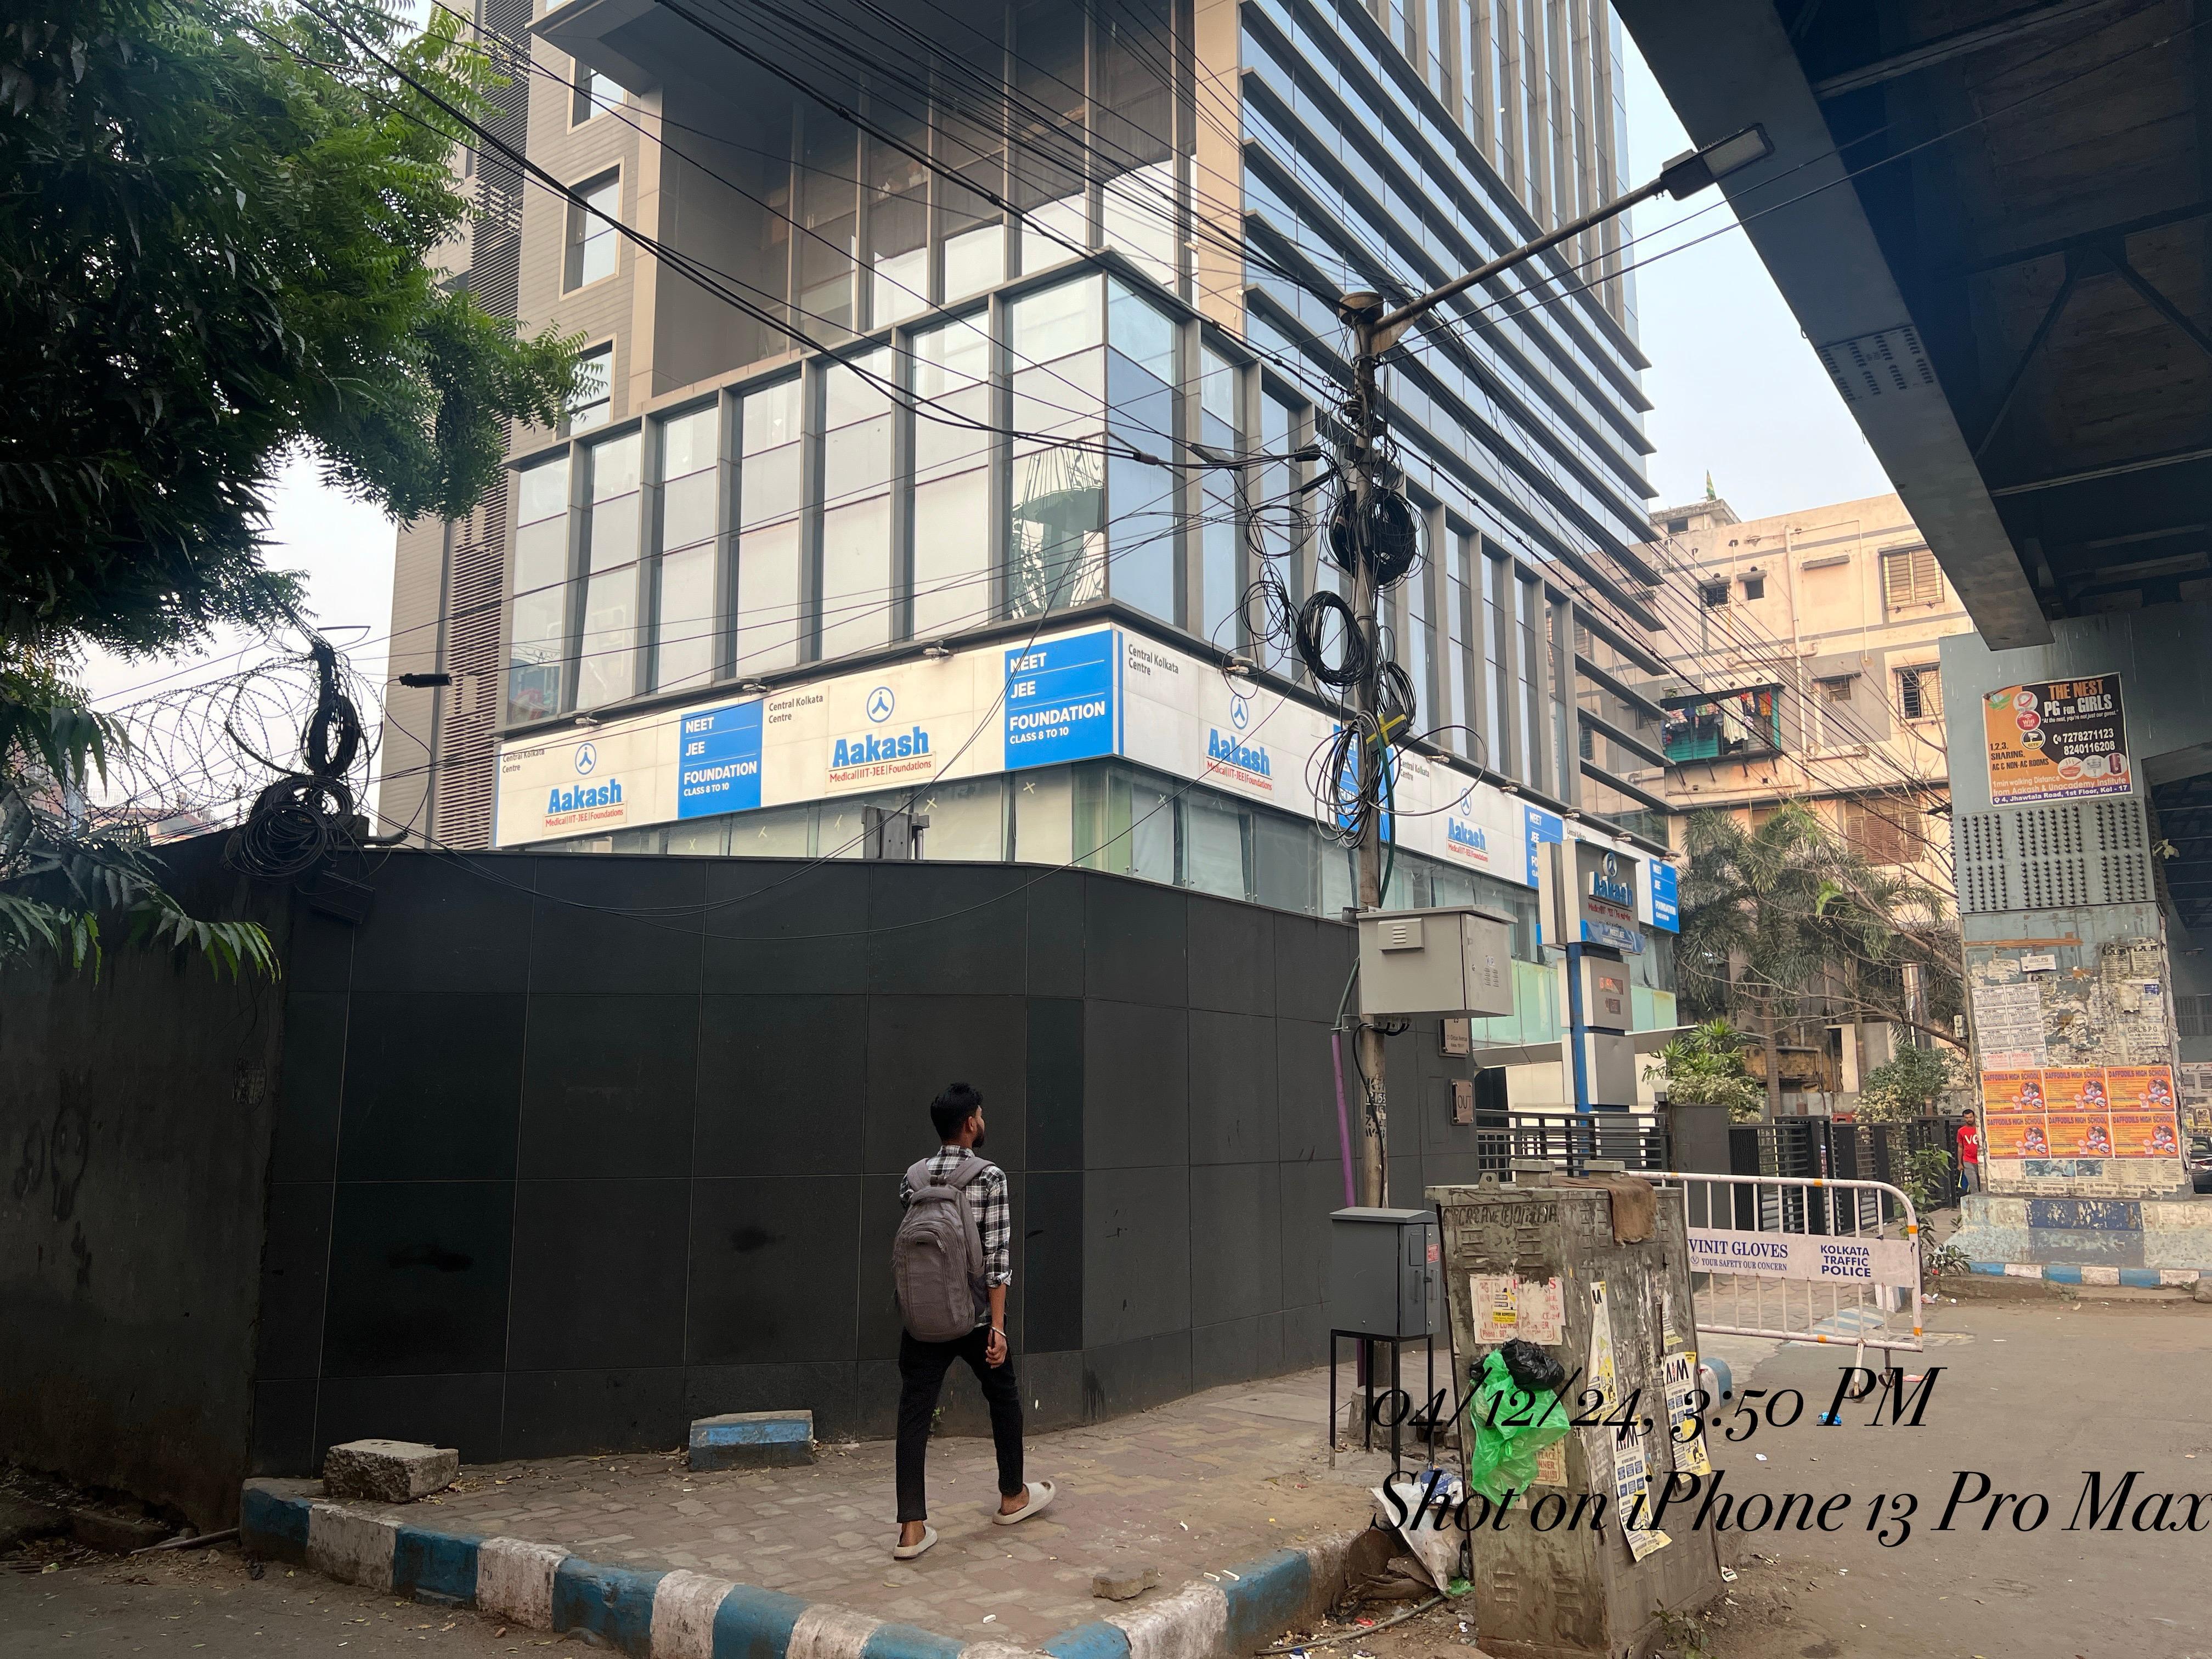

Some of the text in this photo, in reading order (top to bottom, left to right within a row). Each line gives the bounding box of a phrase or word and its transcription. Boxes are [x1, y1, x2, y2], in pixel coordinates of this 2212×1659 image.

[1009, 652, 1047, 673] NEET
[1128, 644, 1179, 674] Central Kolkata
[1128, 657, 1151, 676] Centre
[1010, 680, 1036, 699] JEE
[2048, 679, 2104, 701] THE NEST
[769, 694, 823, 712] Central Kolkata
[2044, 693, 2113, 717] PG FOR GIRLS
[685, 716, 714, 734] NEET
[769, 712, 792, 724] Centre
[1009, 701, 1105, 732] FOUNDATION
[1009, 726, 1069, 745] CLASS 8 TO 10
[2062, 727, 2114, 743] 7278271123
[685, 741, 706, 757] JEE
[832, 725, 929, 768] Aakash
[1208, 728, 1271, 776] Aakash
[2063, 741, 2115, 756] 8240116208
[502, 763, 521, 774] Centre
[2006, 760, 2028, 770] NON-AC
[2028, 758, 2049, 767] ROOMS
[684, 761, 757, 786] FOUNDATION
[2009, 777, 2033, 786] walking
[2034, 775, 2060, 783] Distance
[684, 782, 730, 797] CLASS 8 TO 10
[1993, 788, 2010, 797] from
[2012, 785, 2040, 795] Aakash
[2049, 780, 2095, 790] Unacademy
[2097, 776, 2126, 787] Institute
[547, 778, 623, 815] Aakash
[2010, 793, 2042, 802] Jhawtala
[1530, 812, 1542, 826] NEET
[1448, 817, 1486, 851] Aakash
[1531, 831, 1539, 843] JEE
[1588, 871, 1633, 907] Aakash
[1457, 1095, 1472, 1109] OUT
[1688, 1238, 1788, 1259] VINIT GLOVES
[1820, 1244, 1870, 1256] KOLKATA
[1702, 1257, 1787, 1271] YOUR SAFETY OUR CONCERN
[1824, 1255, 1869, 1267] TRAFFIC
[1821, 1265, 1871, 1278] POLICE
